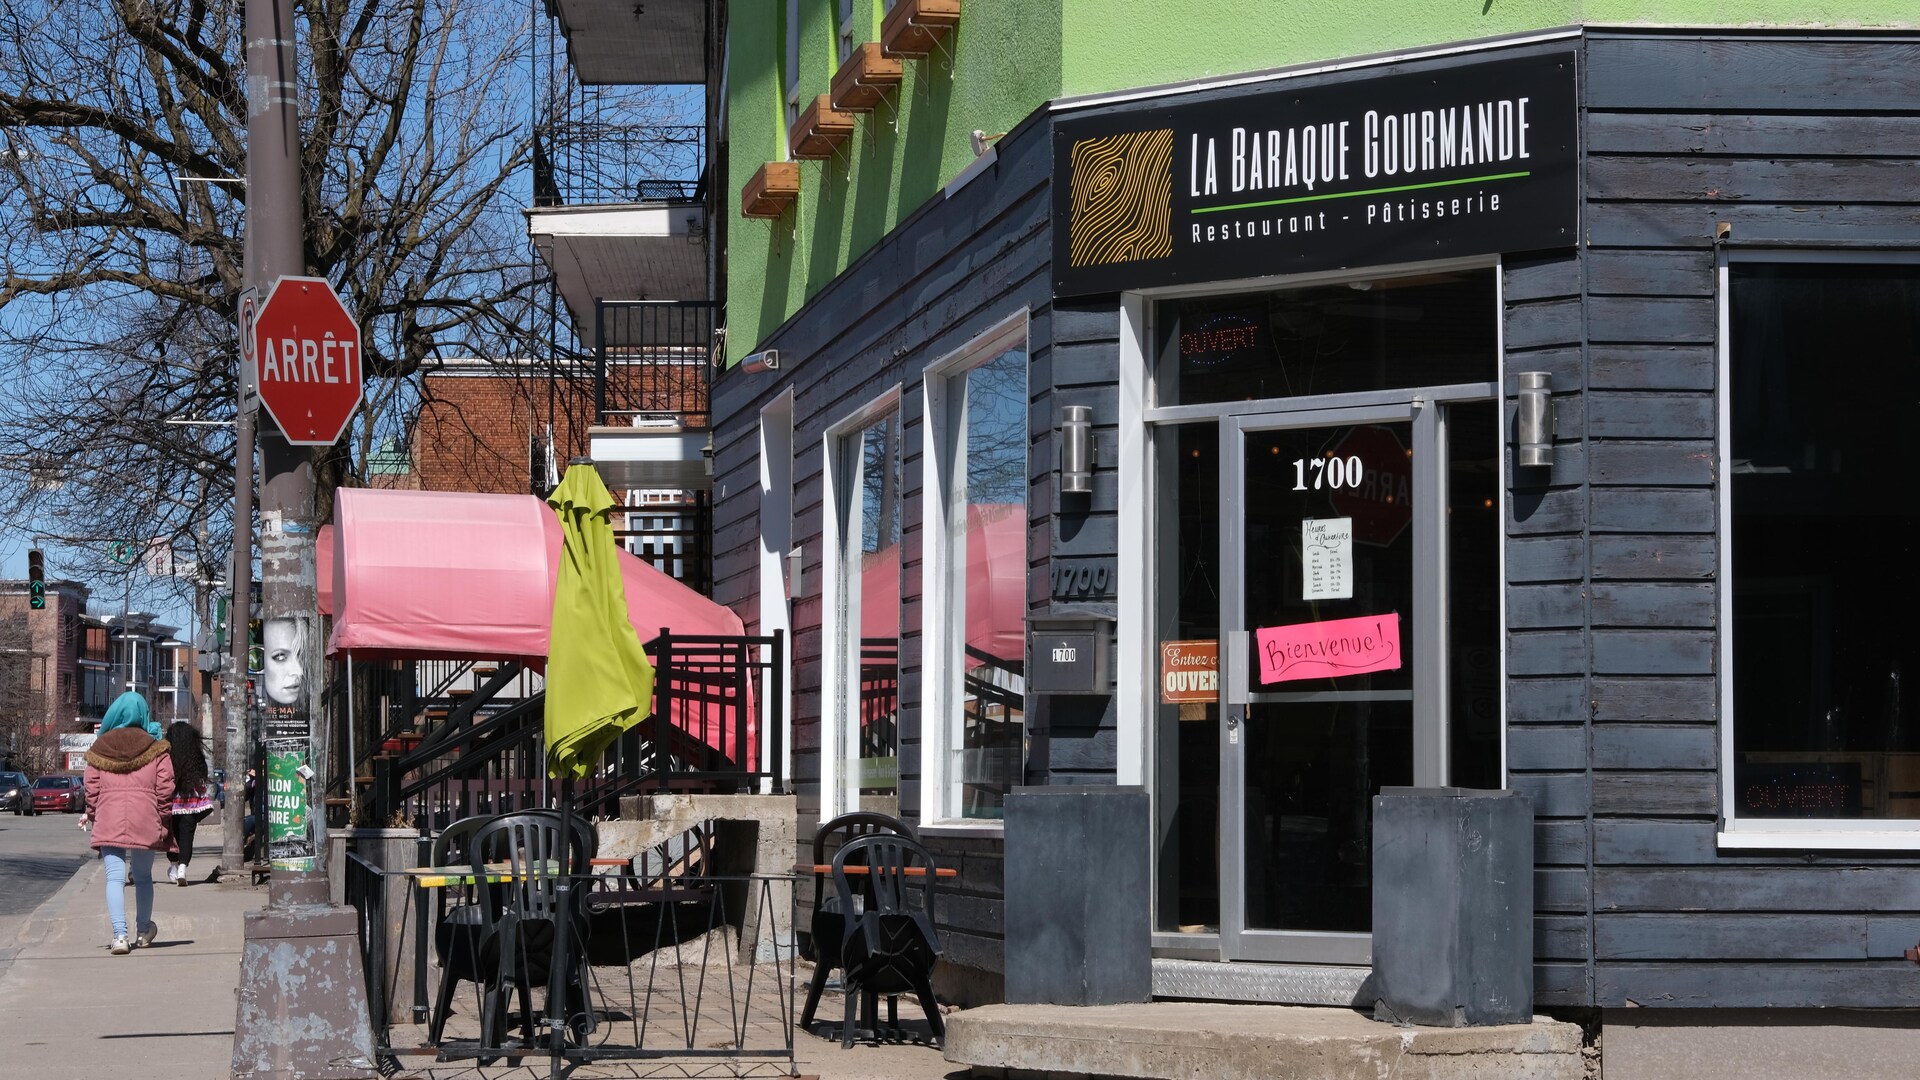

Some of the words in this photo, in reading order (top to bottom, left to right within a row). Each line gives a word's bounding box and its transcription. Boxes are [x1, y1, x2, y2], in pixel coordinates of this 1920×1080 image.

[1192, 211, 1326, 244] Restaurant
[1367, 190, 1501, 225] Pâtisserie
[1180, 326, 1258, 355] OUVERT
[263, 331, 354, 385] ARRÊT
[1292, 455, 1363, 491] 1700
[1052, 565, 1110, 593] 1700
[1054, 649, 1076, 662] 1700
[1166, 648, 1208, 666] Entrez
[1166, 670, 1220, 692] OUVER
[268, 778, 291, 793] ALON
[1747, 785, 1849, 808] OUVERT
[268, 794, 300, 809] UVEAU
[268, 810, 290, 825] ENRE
